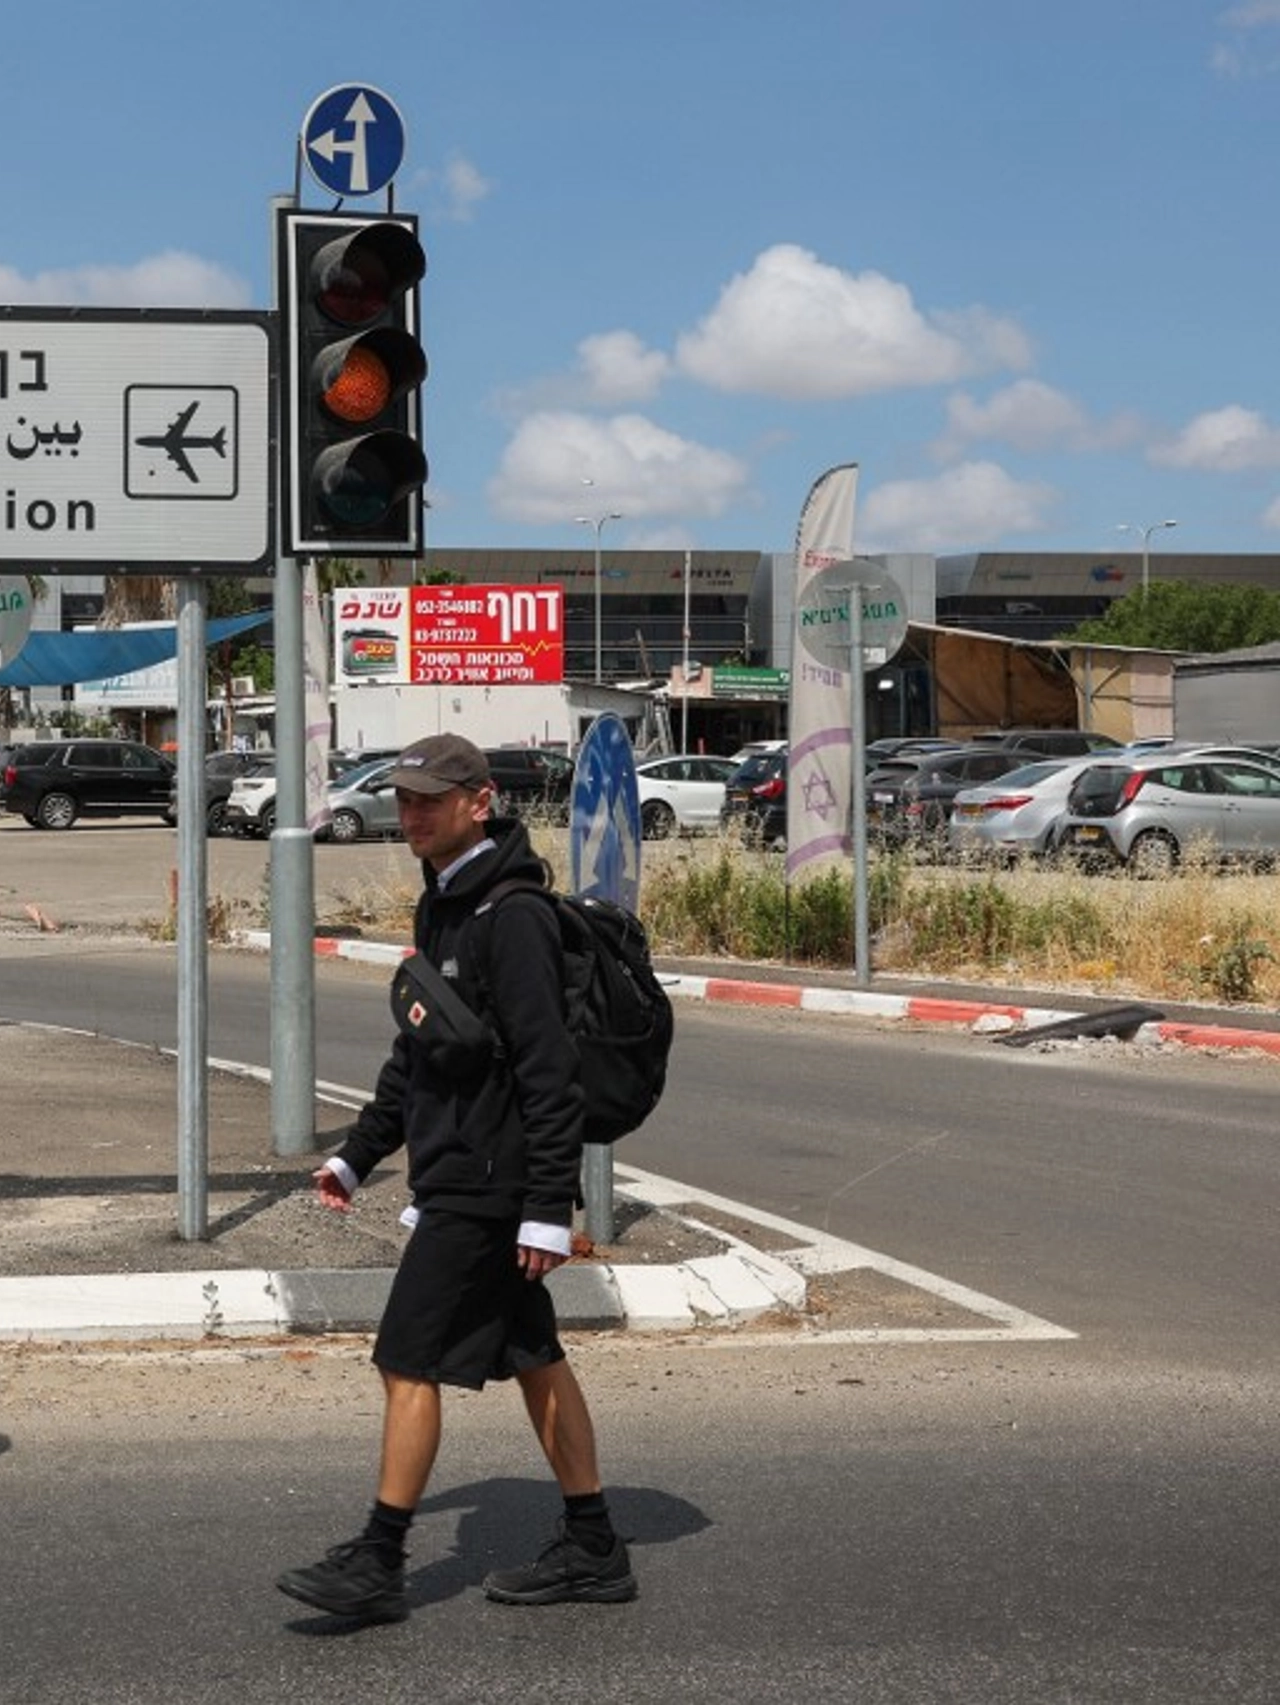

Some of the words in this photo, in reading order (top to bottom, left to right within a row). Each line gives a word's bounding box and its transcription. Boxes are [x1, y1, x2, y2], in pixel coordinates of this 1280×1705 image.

[6, 416, 82, 460] بين
[341, 601, 402, 619] שנפ
[486, 590, 560, 644] דחף
